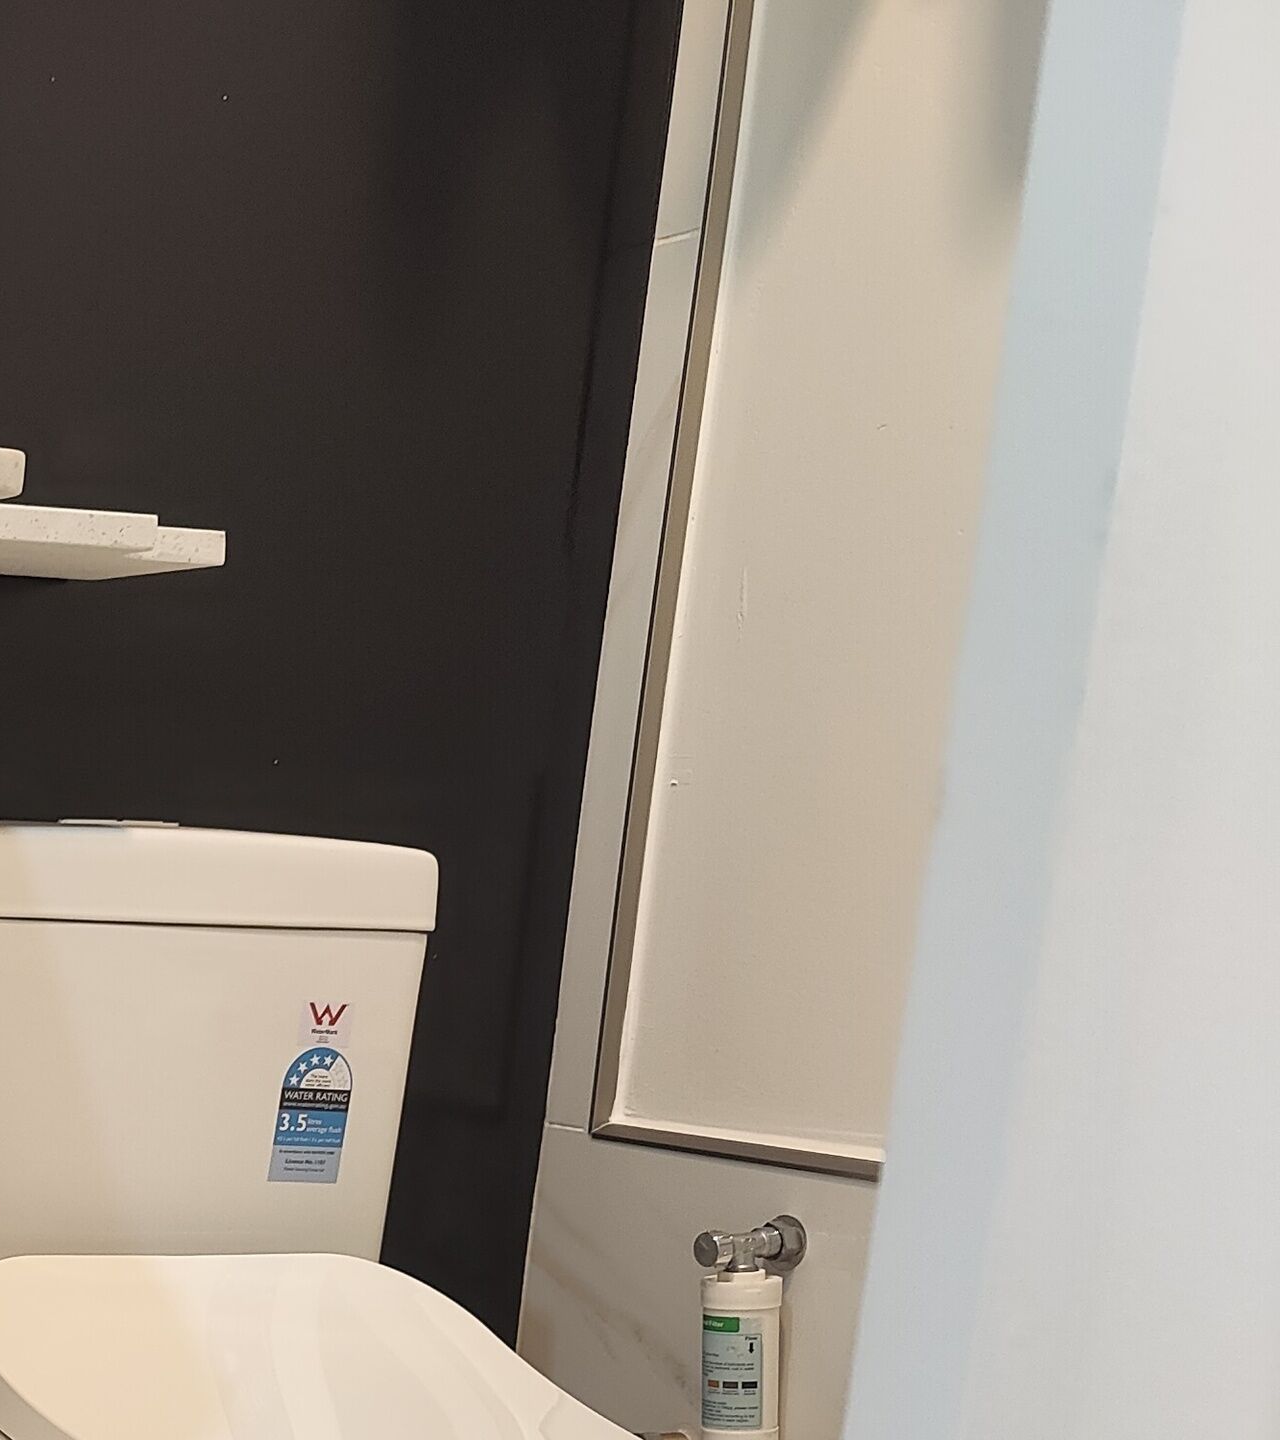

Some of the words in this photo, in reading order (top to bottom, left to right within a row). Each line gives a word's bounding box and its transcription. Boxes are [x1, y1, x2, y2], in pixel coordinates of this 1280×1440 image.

[284, 1090, 314, 1100] WATER
[315, 1092, 349, 1103] RATING
[279, 1112, 308, 1132] 3.5
